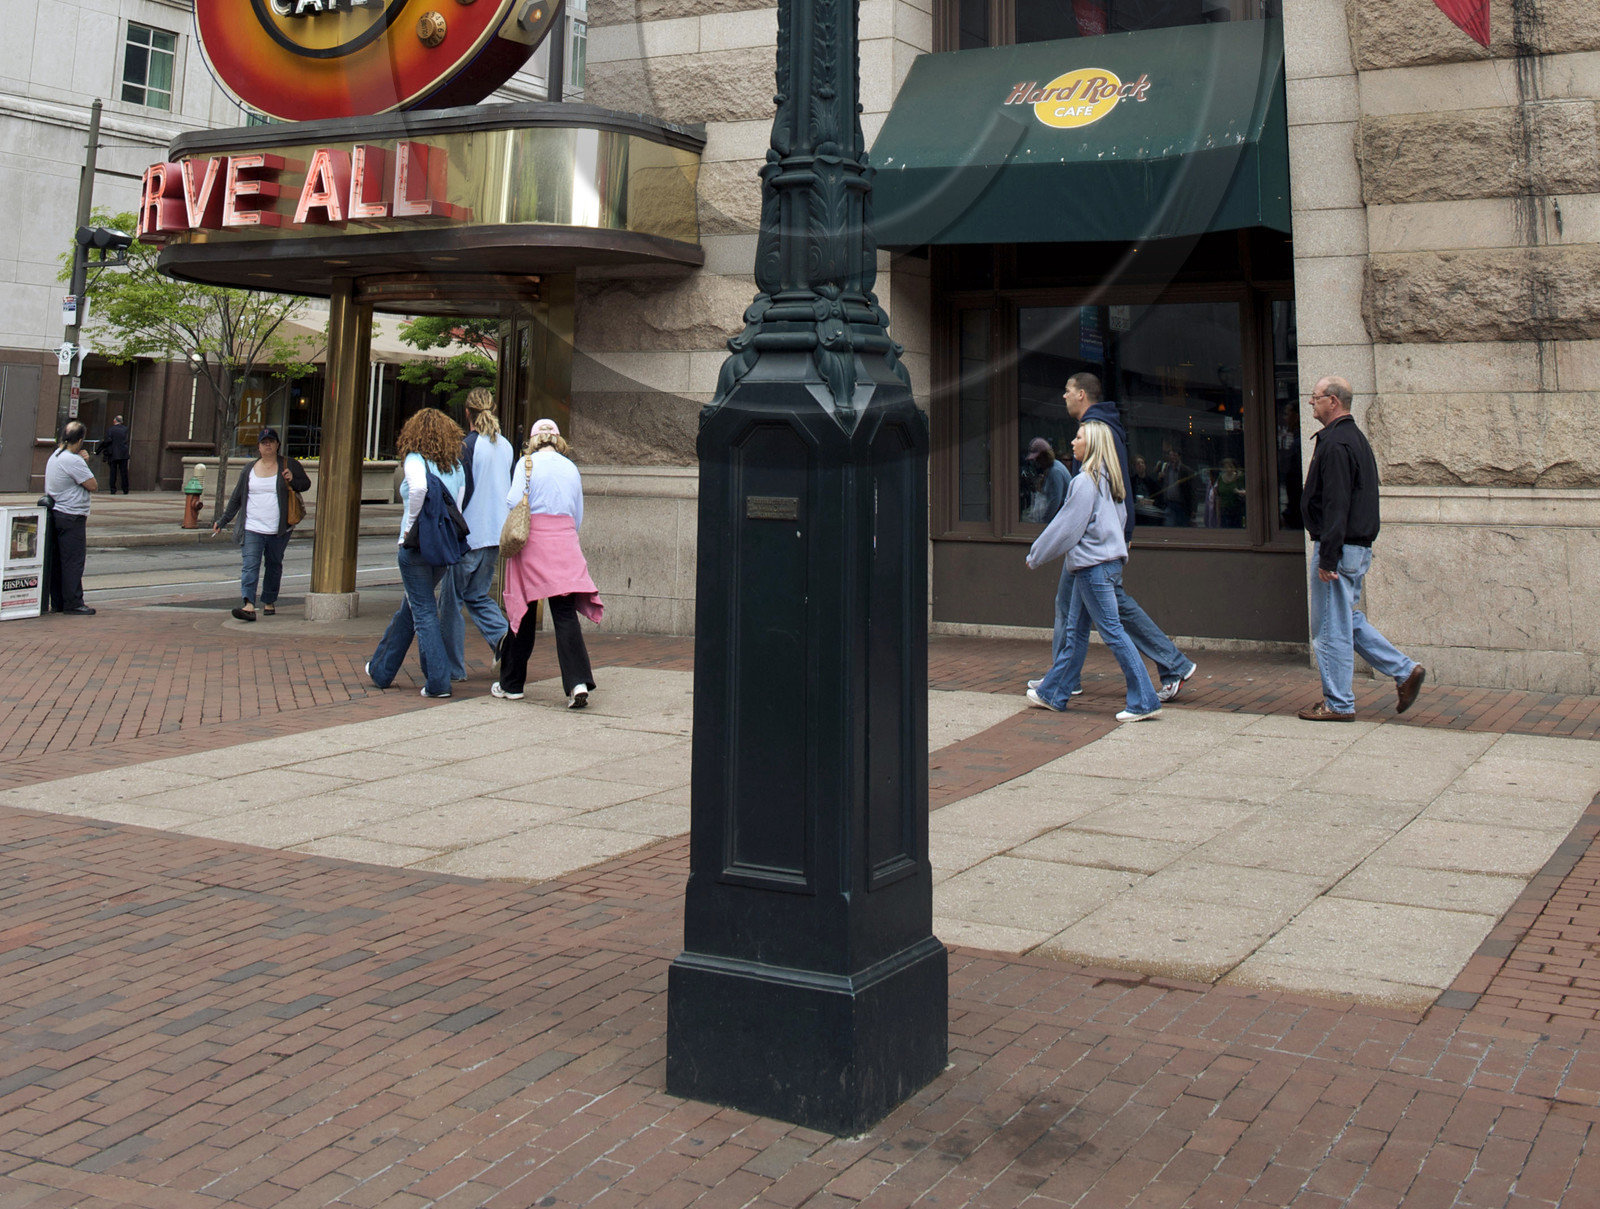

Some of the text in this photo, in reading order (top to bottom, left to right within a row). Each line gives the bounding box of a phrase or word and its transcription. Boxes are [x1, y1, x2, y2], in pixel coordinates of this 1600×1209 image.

[1004, 74, 1151, 105] Hard Rock
[293, 141, 433, 224] ALL
